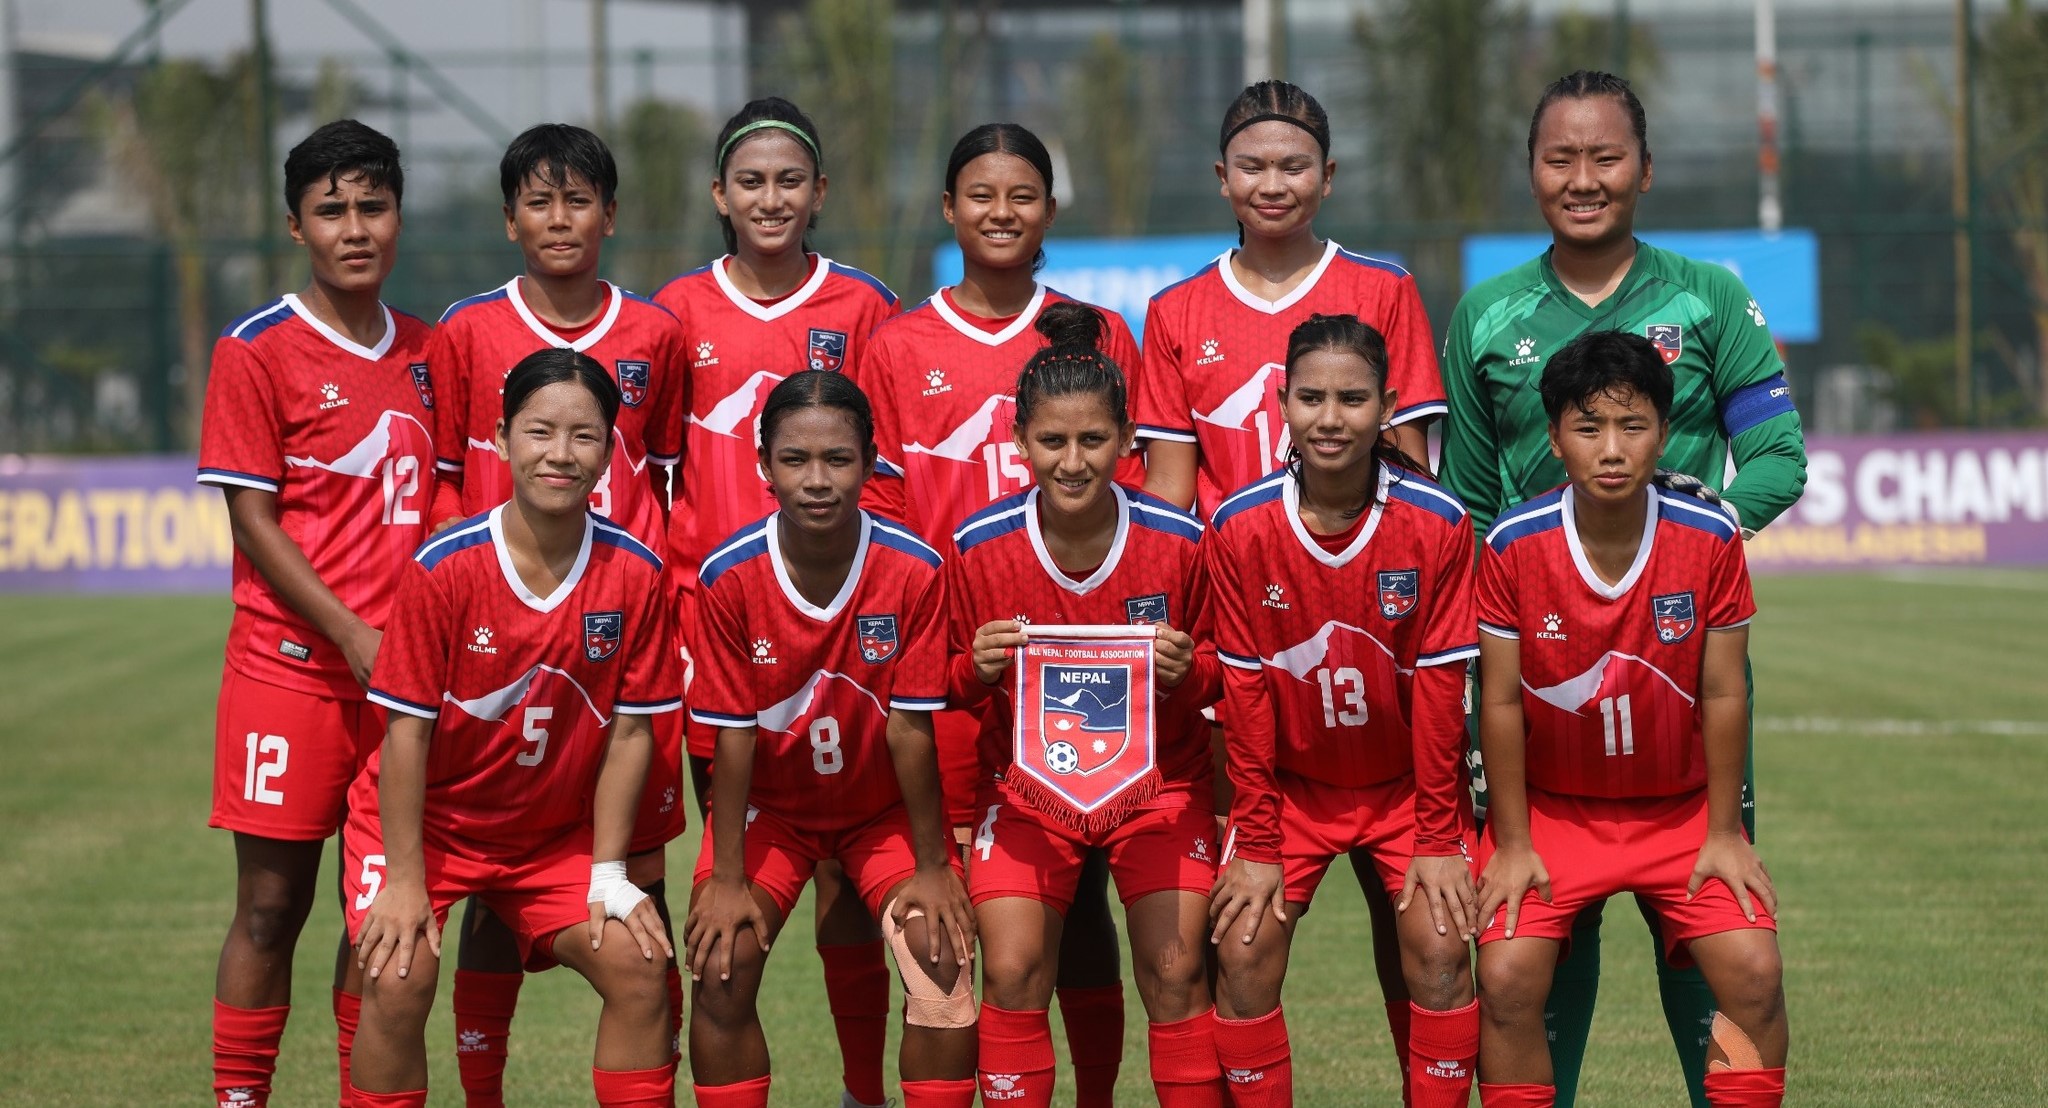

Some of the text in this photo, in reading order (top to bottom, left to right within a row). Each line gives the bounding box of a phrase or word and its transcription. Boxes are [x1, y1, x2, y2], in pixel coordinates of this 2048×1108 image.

[694, 357, 719, 368] KELME
[1196, 354, 1225, 366] KELME
[1509, 356, 1540, 367] KELME
[922, 384, 952, 397] KELME
[319, 398, 349, 410] KELME
[983, 441, 1030, 501] 15
[381, 455, 421, 525] 12
[1854, 446, 2048, 525] CHAM
[1138, 600, 1156, 608] NEPAL
[1262, 599, 1291, 610] KELME
[1664, 599, 1684, 607] NEPAL
[1536, 631, 1567, 641] KELME
[467, 643, 497, 655] KELME
[1028, 648, 1145, 660] ALL NEPAL FOOTBALL ASSOCIATION
[752, 656, 778, 665] ELME
[1060, 672, 1111, 684] NEPAL
[1317, 667, 1369, 728] 13
[1600, 694, 1634, 756] 11
[515, 706, 554, 767] 5
[808, 715, 844, 775] 8
[244, 732, 290, 806] 12
[355, 854, 387, 911] 5
[1426, 1066, 1467, 1079] KELME
[984, 1088, 1026, 1100] KELME
